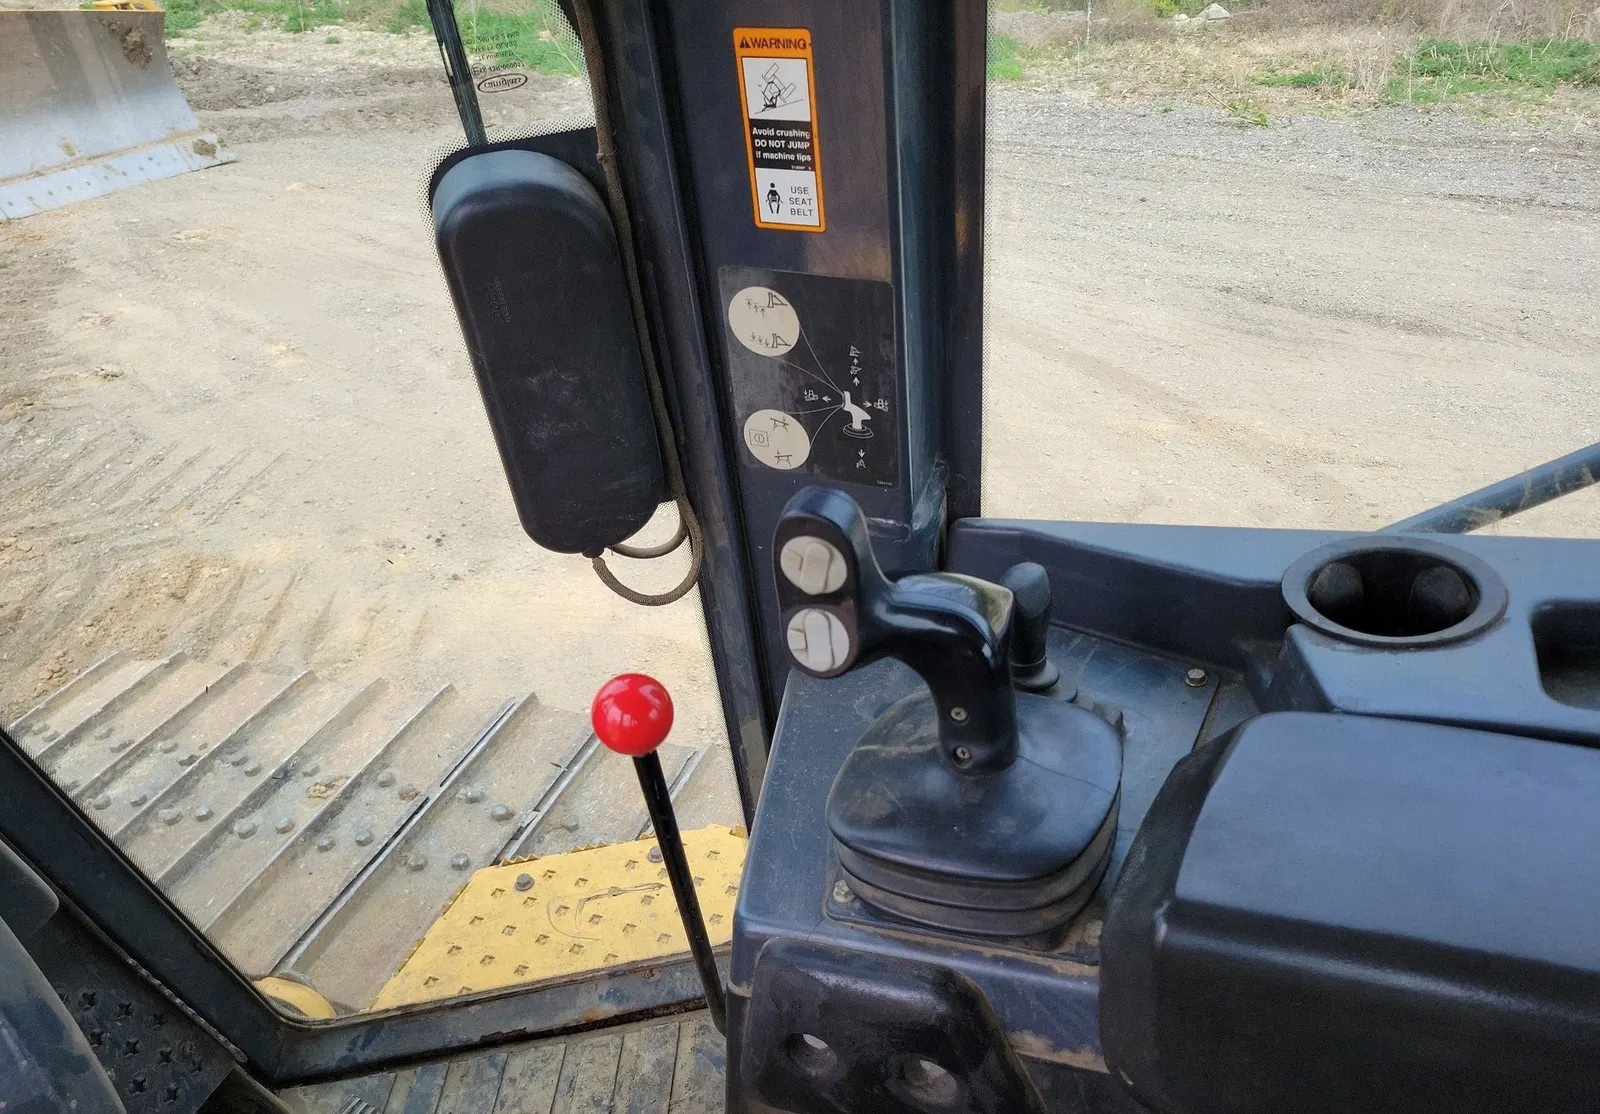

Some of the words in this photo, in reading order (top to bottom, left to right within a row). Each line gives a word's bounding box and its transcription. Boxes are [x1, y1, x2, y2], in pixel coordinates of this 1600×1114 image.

[750, 37, 807, 49] WARNING
[752, 127, 774, 136] Avoid
[776, 128, 810, 139] crushing
[755, 139, 767, 147] DO
[768, 140, 785, 148] NOT
[787, 141, 810, 149] JUMP
[763, 151, 795, 160] machine
[797, 153, 812, 162] tips
[790, 186, 809, 194] USE
[789, 197, 813, 206] SEAT
[790, 208, 813, 217] BELT
